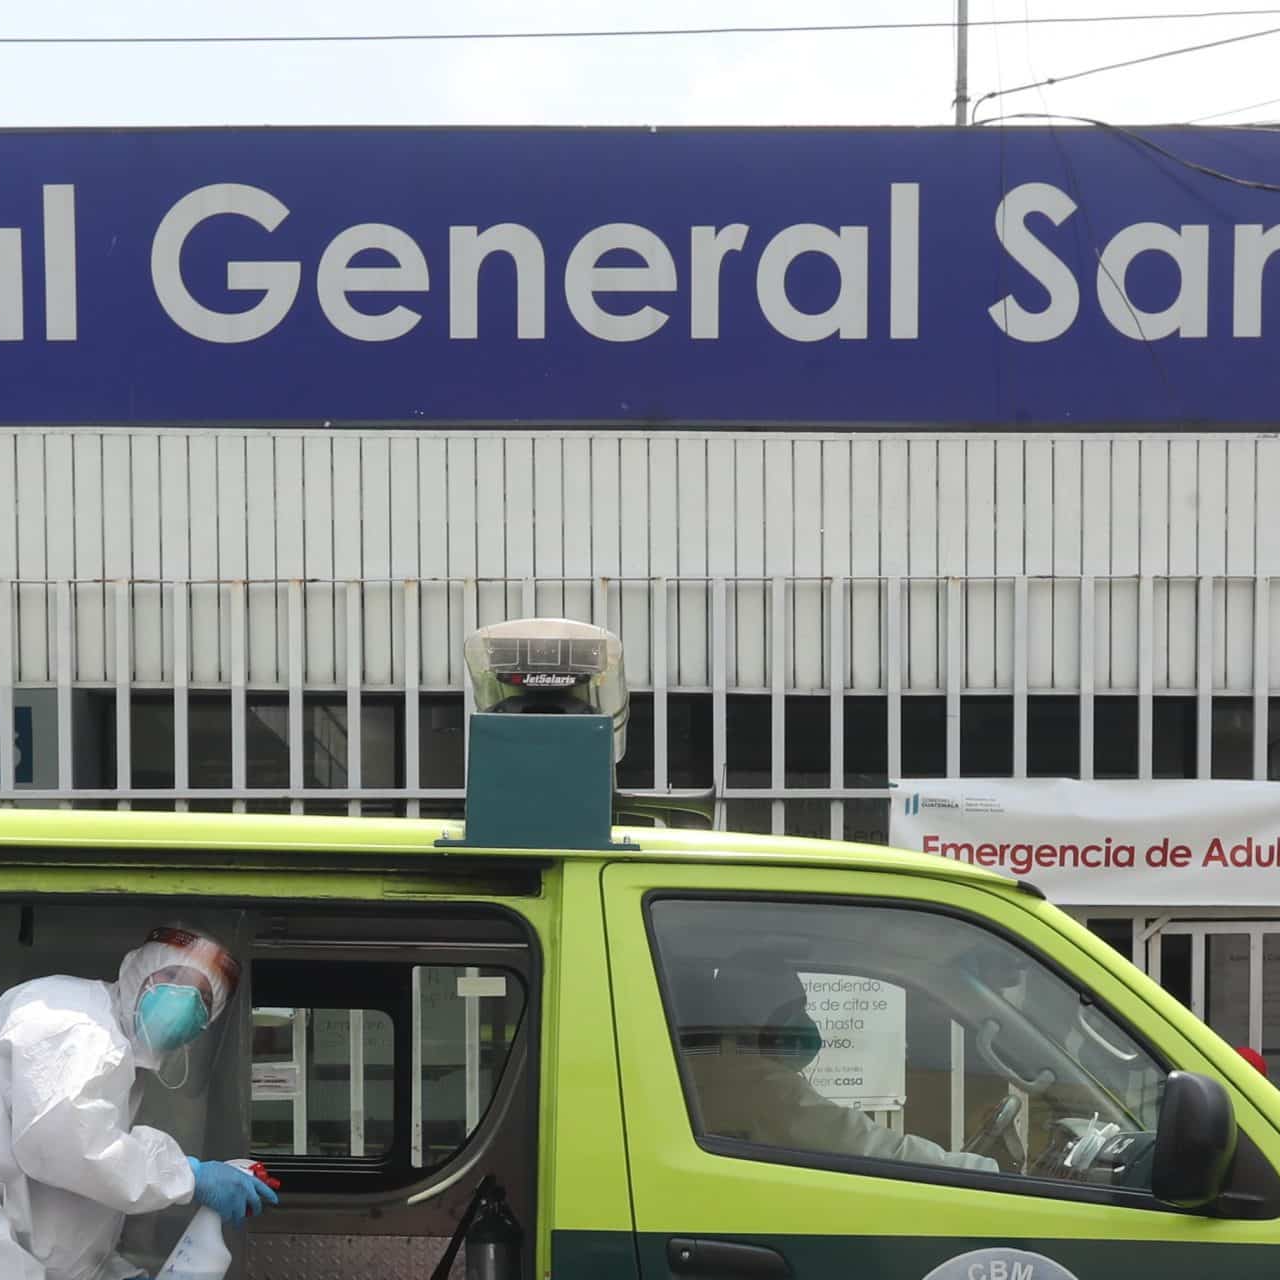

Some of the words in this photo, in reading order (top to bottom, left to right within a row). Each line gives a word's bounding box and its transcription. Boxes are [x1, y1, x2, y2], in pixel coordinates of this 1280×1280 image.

[150, 182, 920, 344] General
[922, 835, 1135, 874] Emergencia
[1145, 839, 1192, 868] de
[820, 999, 840, 1012] de
[842, 998, 869, 1011] cita
[872, 1000, 888, 1011] se
[825, 1017, 864, 1030] hasta
